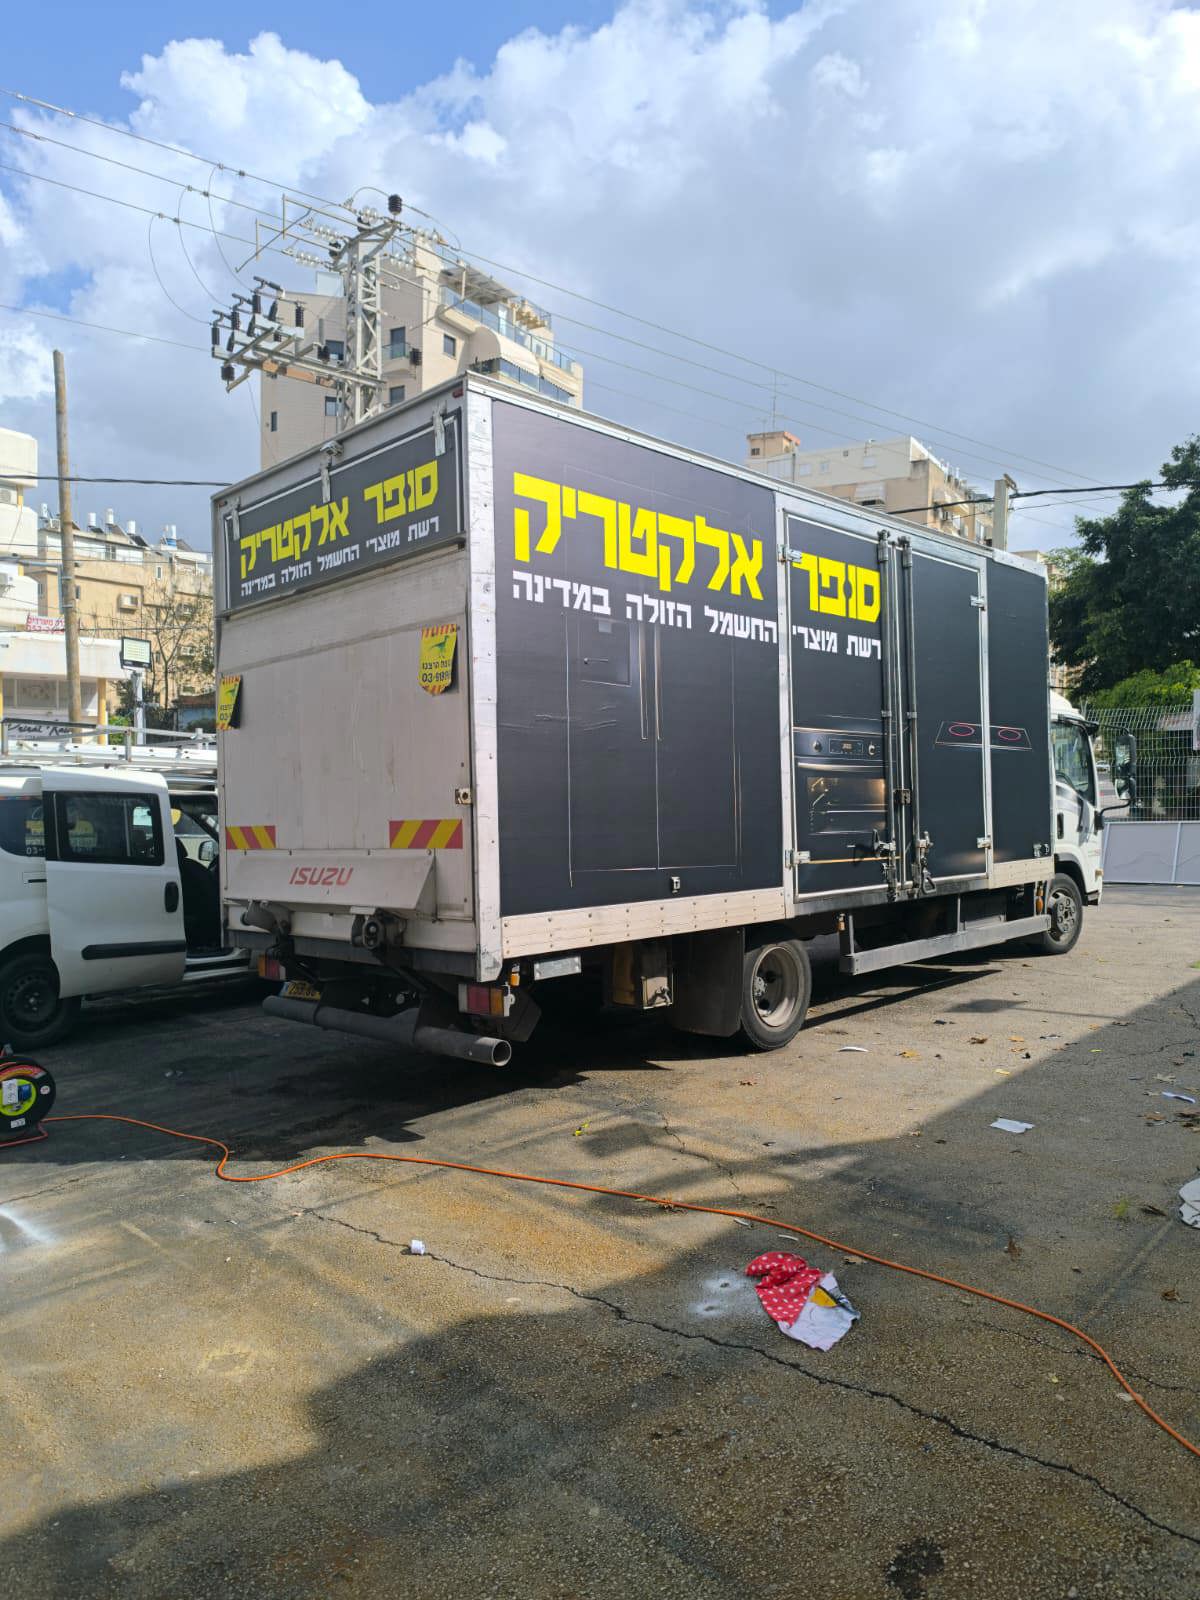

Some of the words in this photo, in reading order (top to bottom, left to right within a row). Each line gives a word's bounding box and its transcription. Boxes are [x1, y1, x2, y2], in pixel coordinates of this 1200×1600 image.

[364, 460, 438, 524] סופר
[240, 497, 350, 579] אלקטריק
[365, 530, 400, 553] מוצרי
[408, 516, 440, 541] רשת
[513, 472, 764, 600] אלקטריק
[317, 544, 359, 571] החשמל
[241, 573, 275, 597] במדינה
[281, 561, 312, 584] הזולה
[512, 570, 611, 615] במדינה
[792, 552, 881, 623] סופר
[626, 593, 692, 629] הזולה
[704, 605, 778, 644] החשמל
[792, 625, 838, 653] מוצרי
[846, 635, 881, 660] רשת
[289, 867, 354, 885] ISUZU
